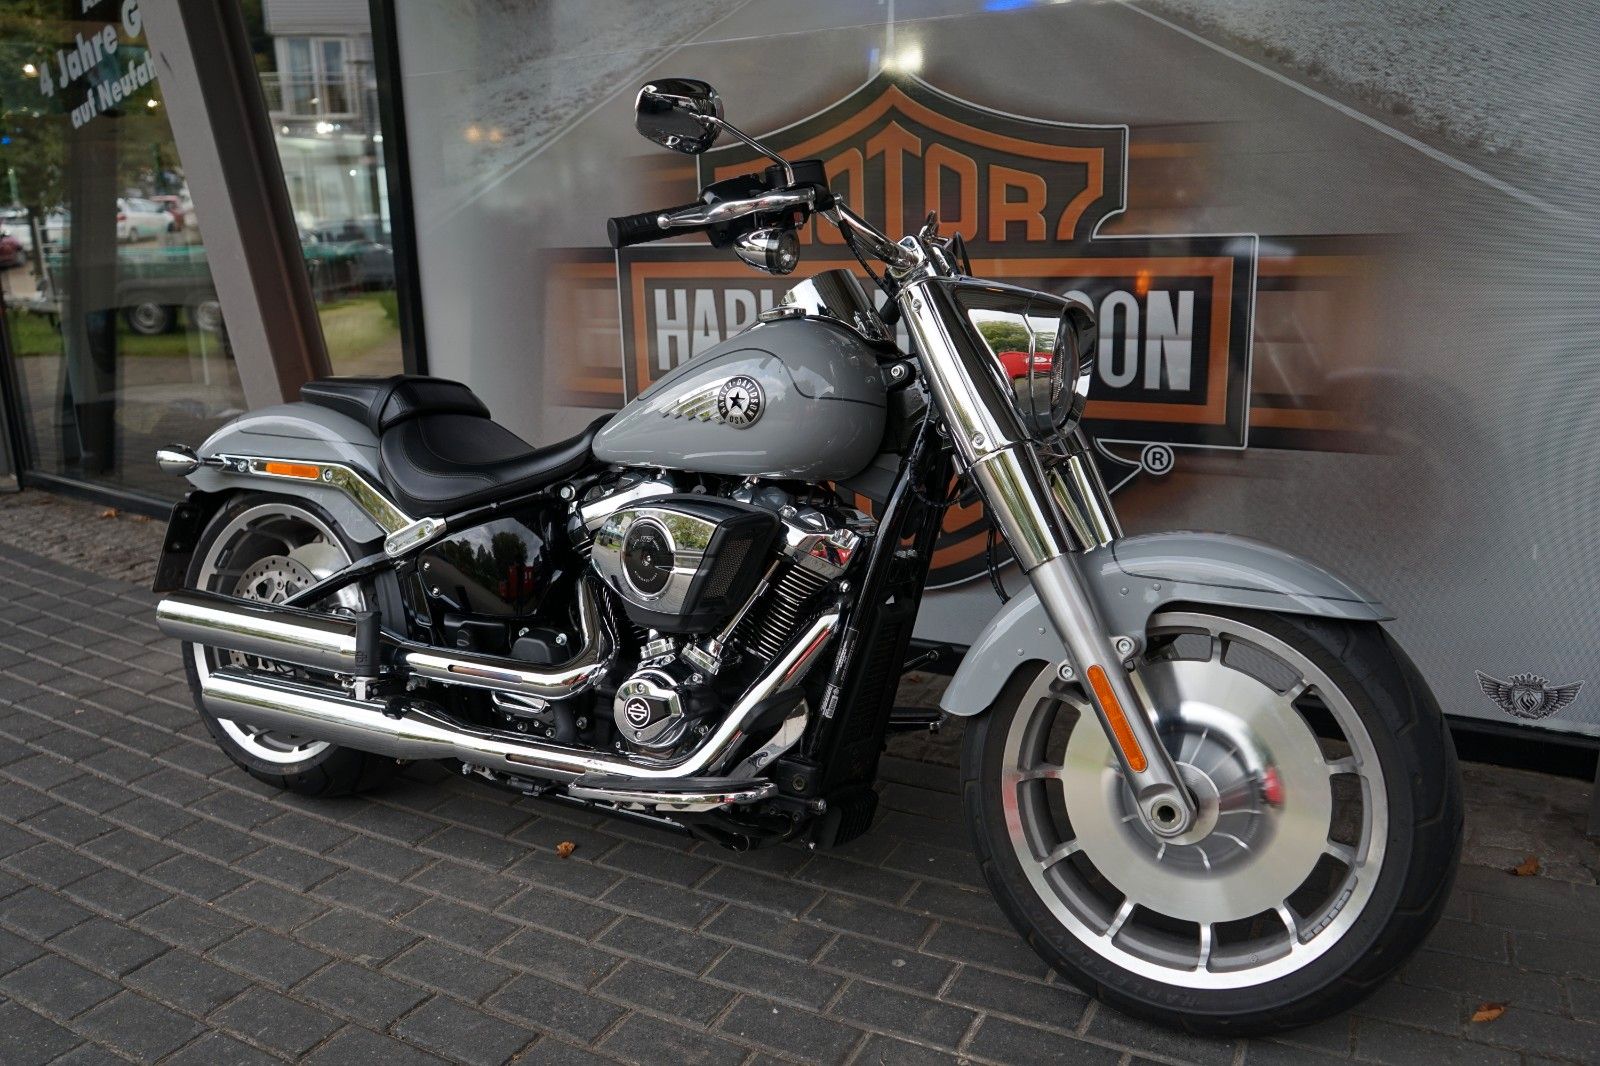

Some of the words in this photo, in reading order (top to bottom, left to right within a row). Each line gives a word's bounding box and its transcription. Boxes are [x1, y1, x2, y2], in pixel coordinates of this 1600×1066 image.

[40, 61, 54, 97] 4
[56, 24, 118, 89] Jahre
[71, 88, 97, 129] auf
[797, 120, 1047, 246] OTOR
[729, 414, 746, 425] USA
